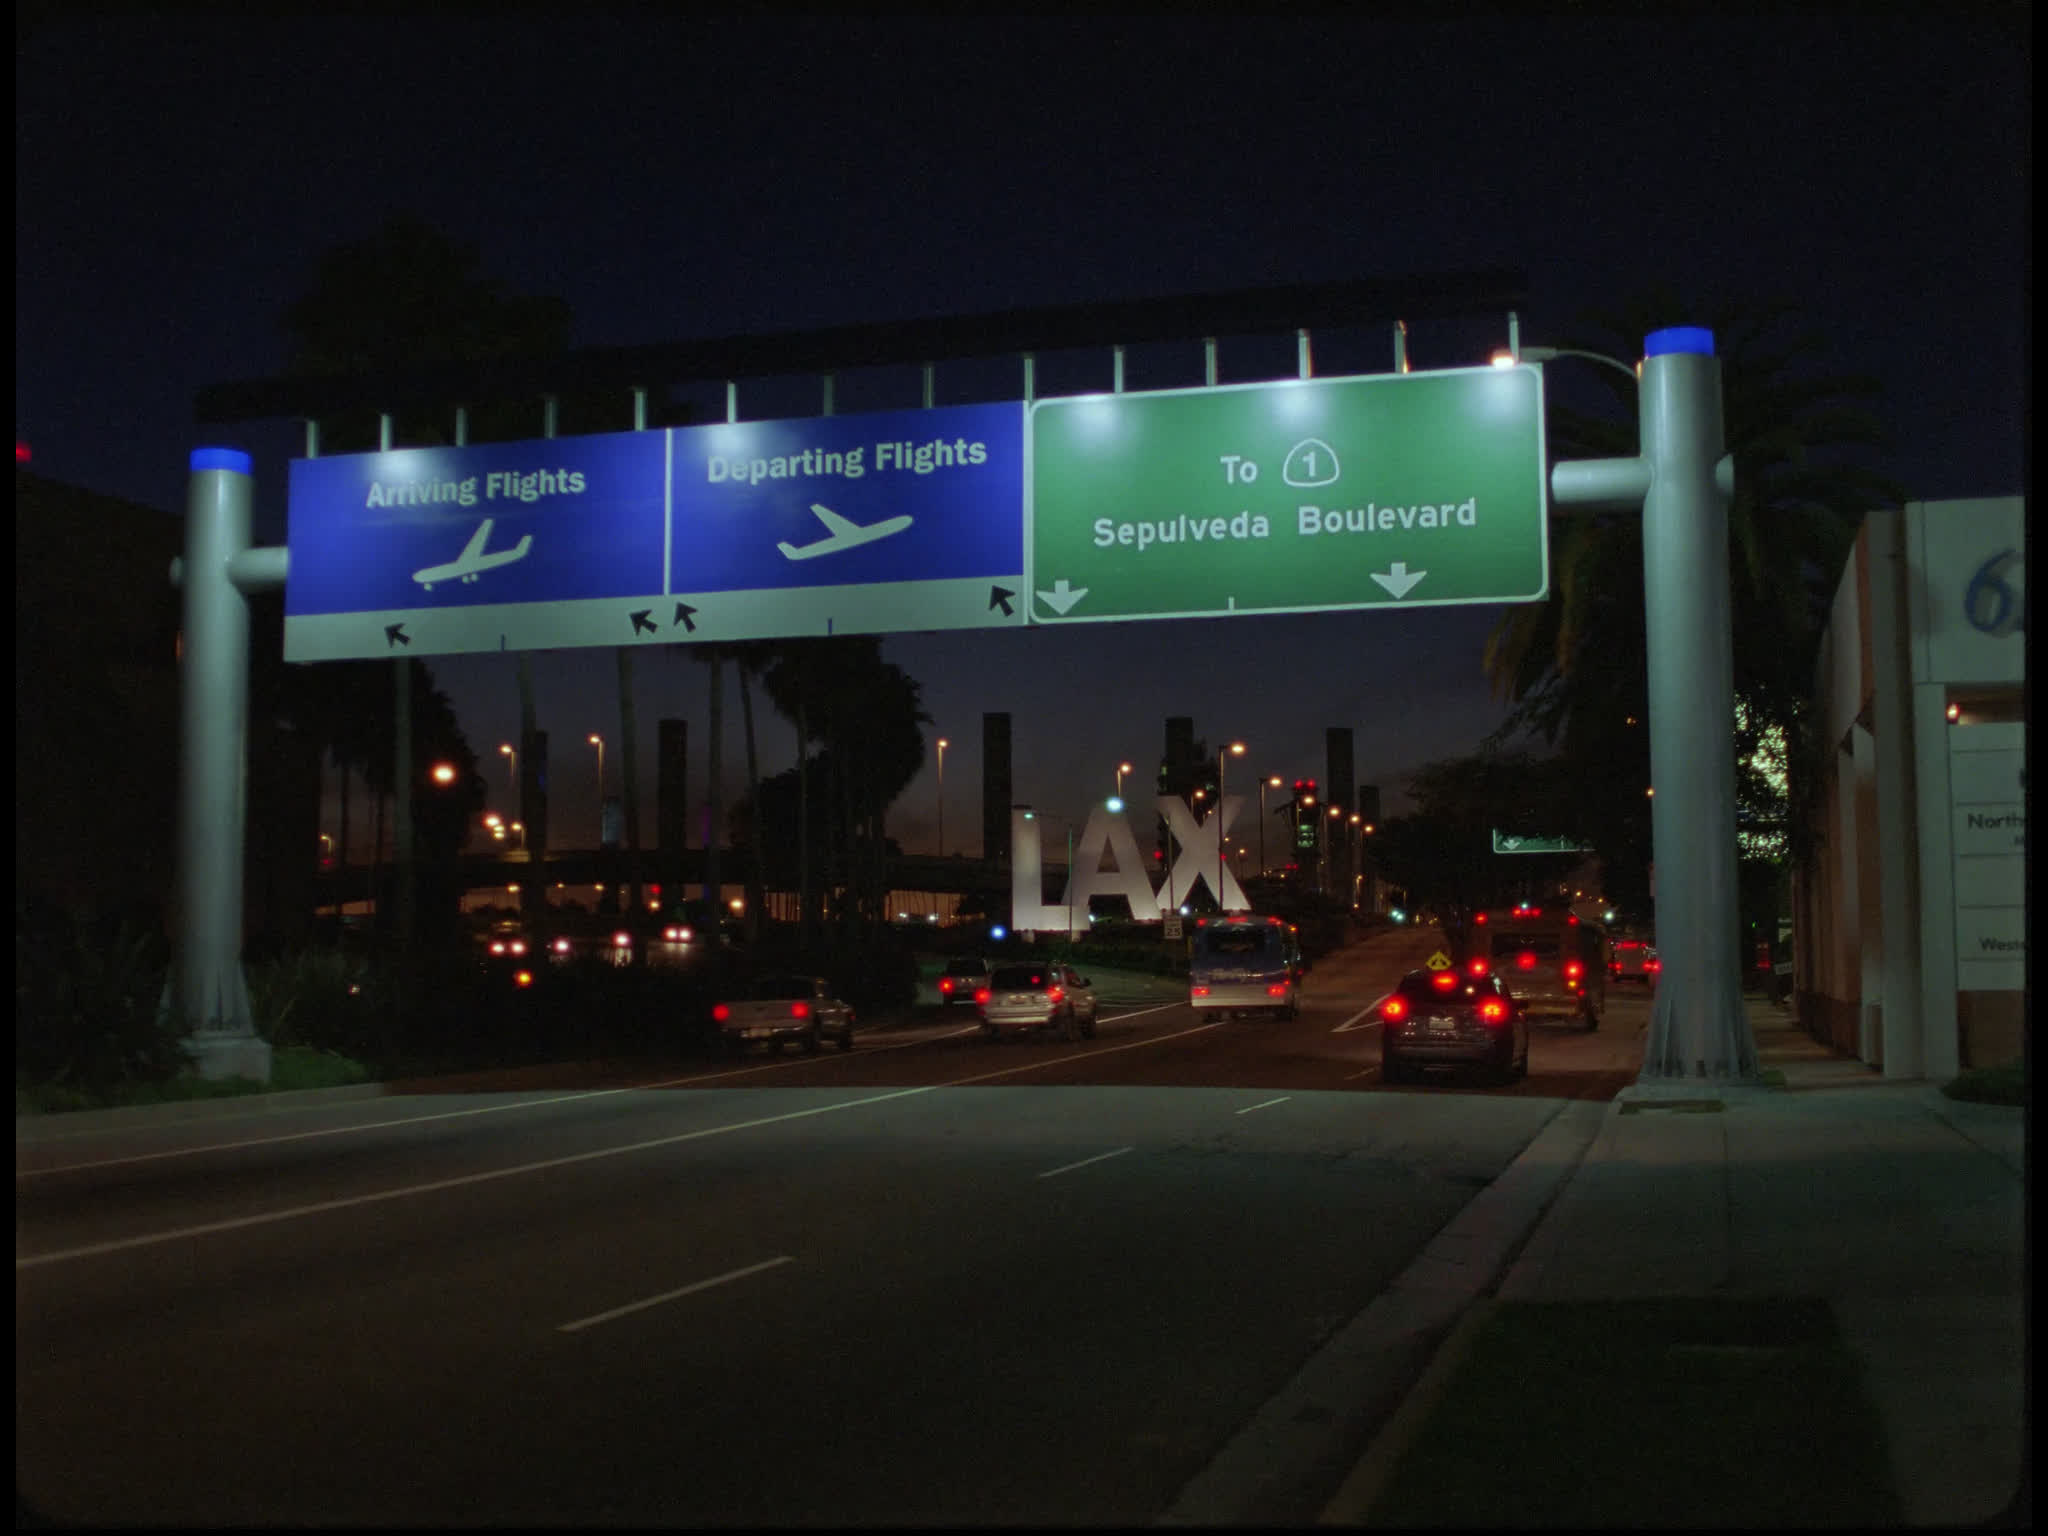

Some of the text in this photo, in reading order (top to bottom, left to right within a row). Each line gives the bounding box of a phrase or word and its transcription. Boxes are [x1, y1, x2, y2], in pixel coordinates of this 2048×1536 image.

[706, 438, 988, 485] Departing Flights
[1219, 451, 1317, 484] To 1
[365, 468, 587, 508] Arriving Flights
[1092, 496, 1478, 551] Sepulveda Boulevard
[1967, 813, 2028, 829] North
[1011, 794, 1253, 930] LAX
